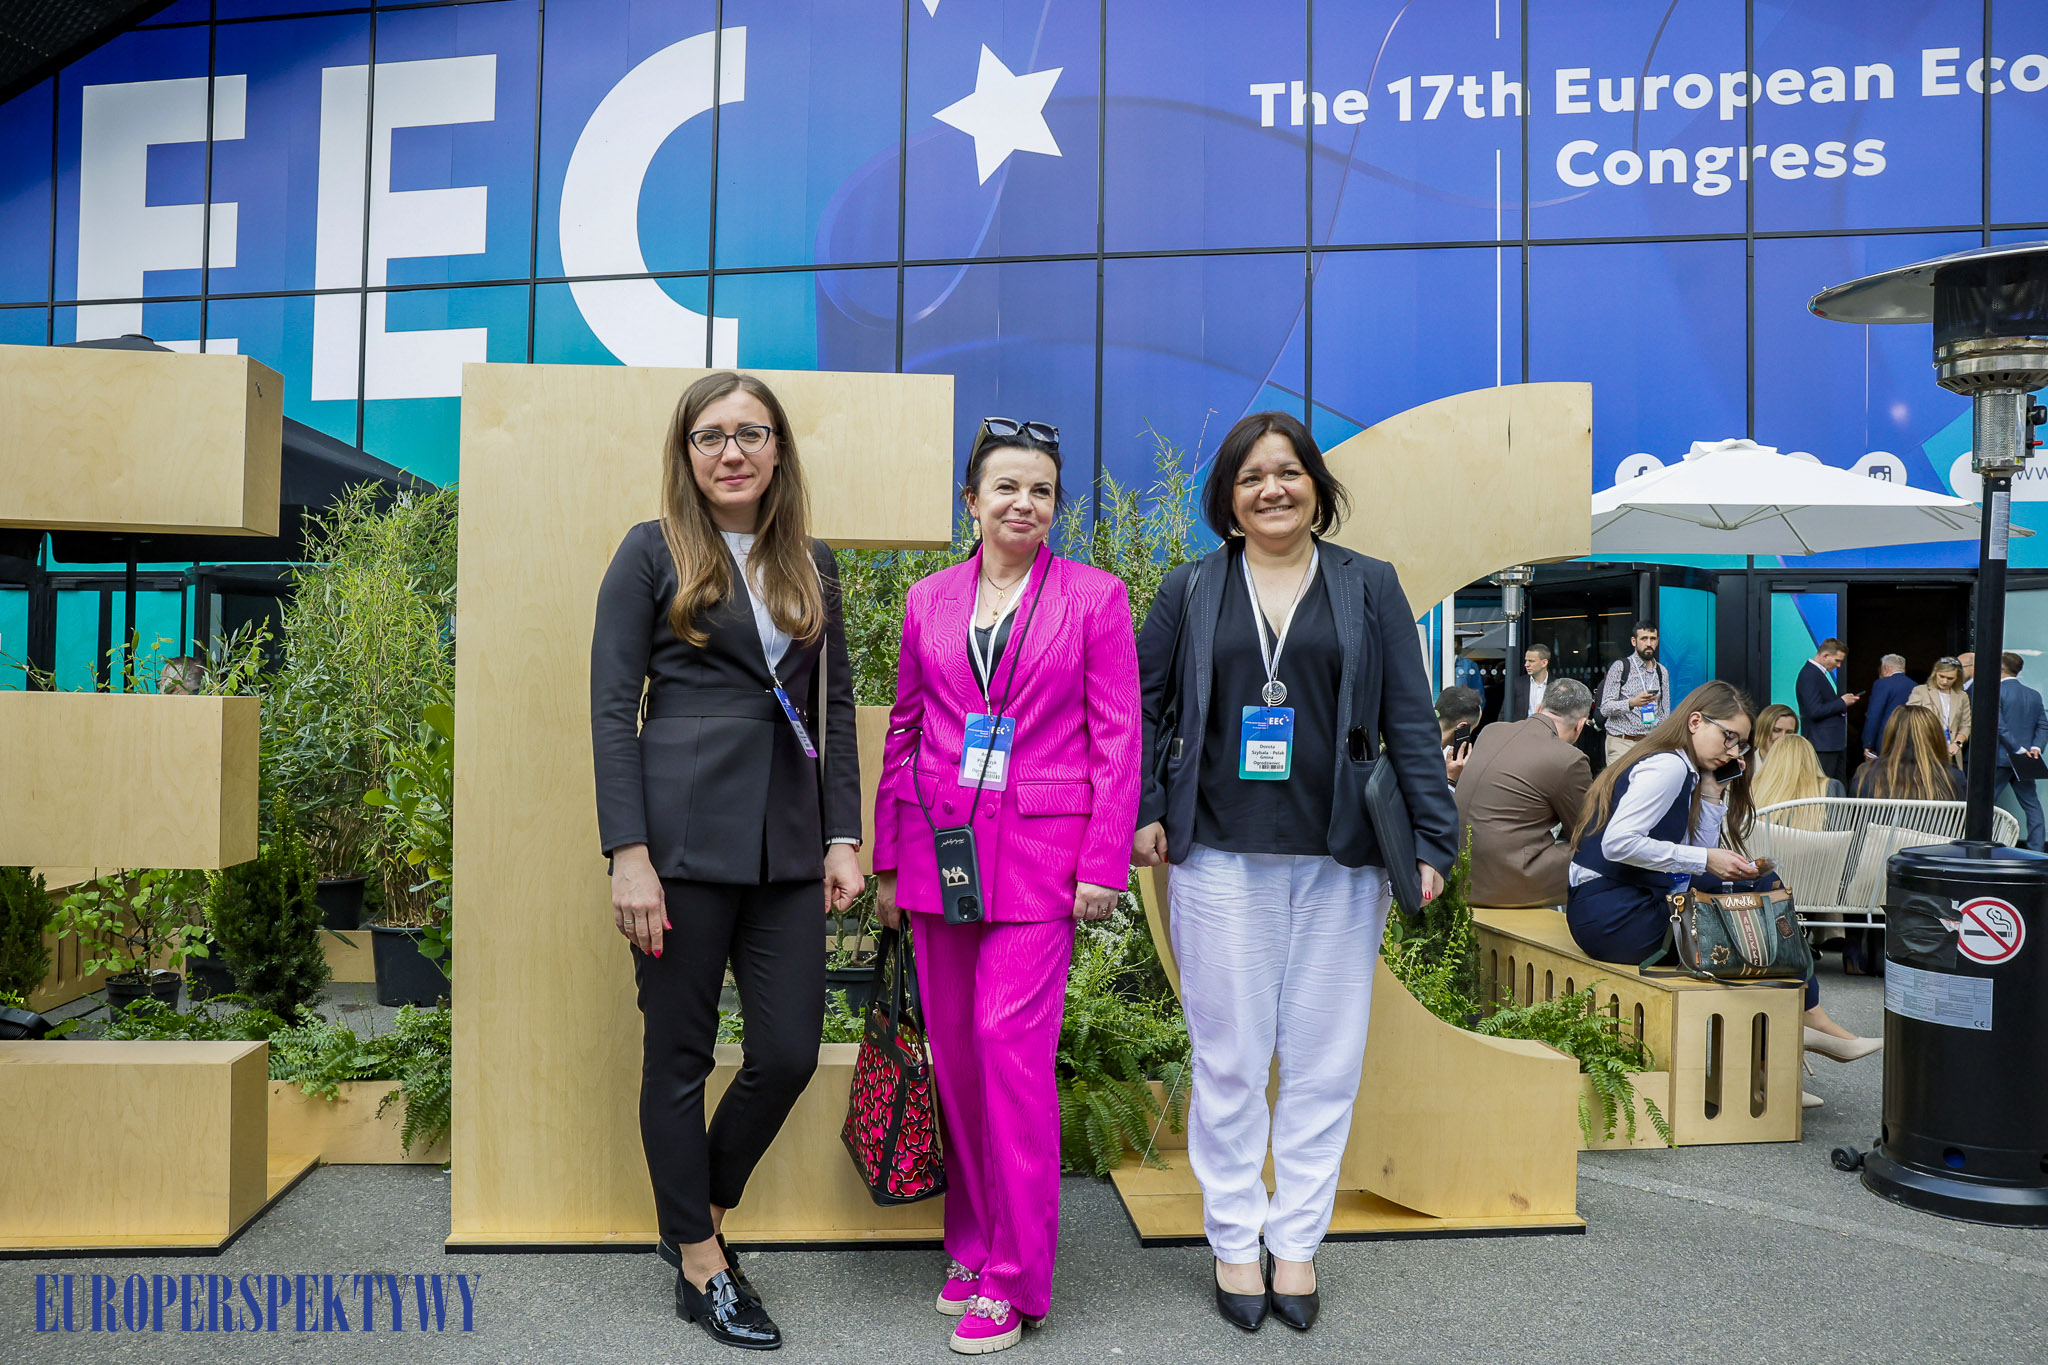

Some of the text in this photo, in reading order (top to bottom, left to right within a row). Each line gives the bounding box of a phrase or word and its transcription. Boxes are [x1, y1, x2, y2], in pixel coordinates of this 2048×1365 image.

[1250, 47, 2048, 127] The 17th European Eco
[1556, 139, 1887, 197] Congress
[76, 26, 747, 401] EEC
[1269, 717, 1284, 726] EEC
